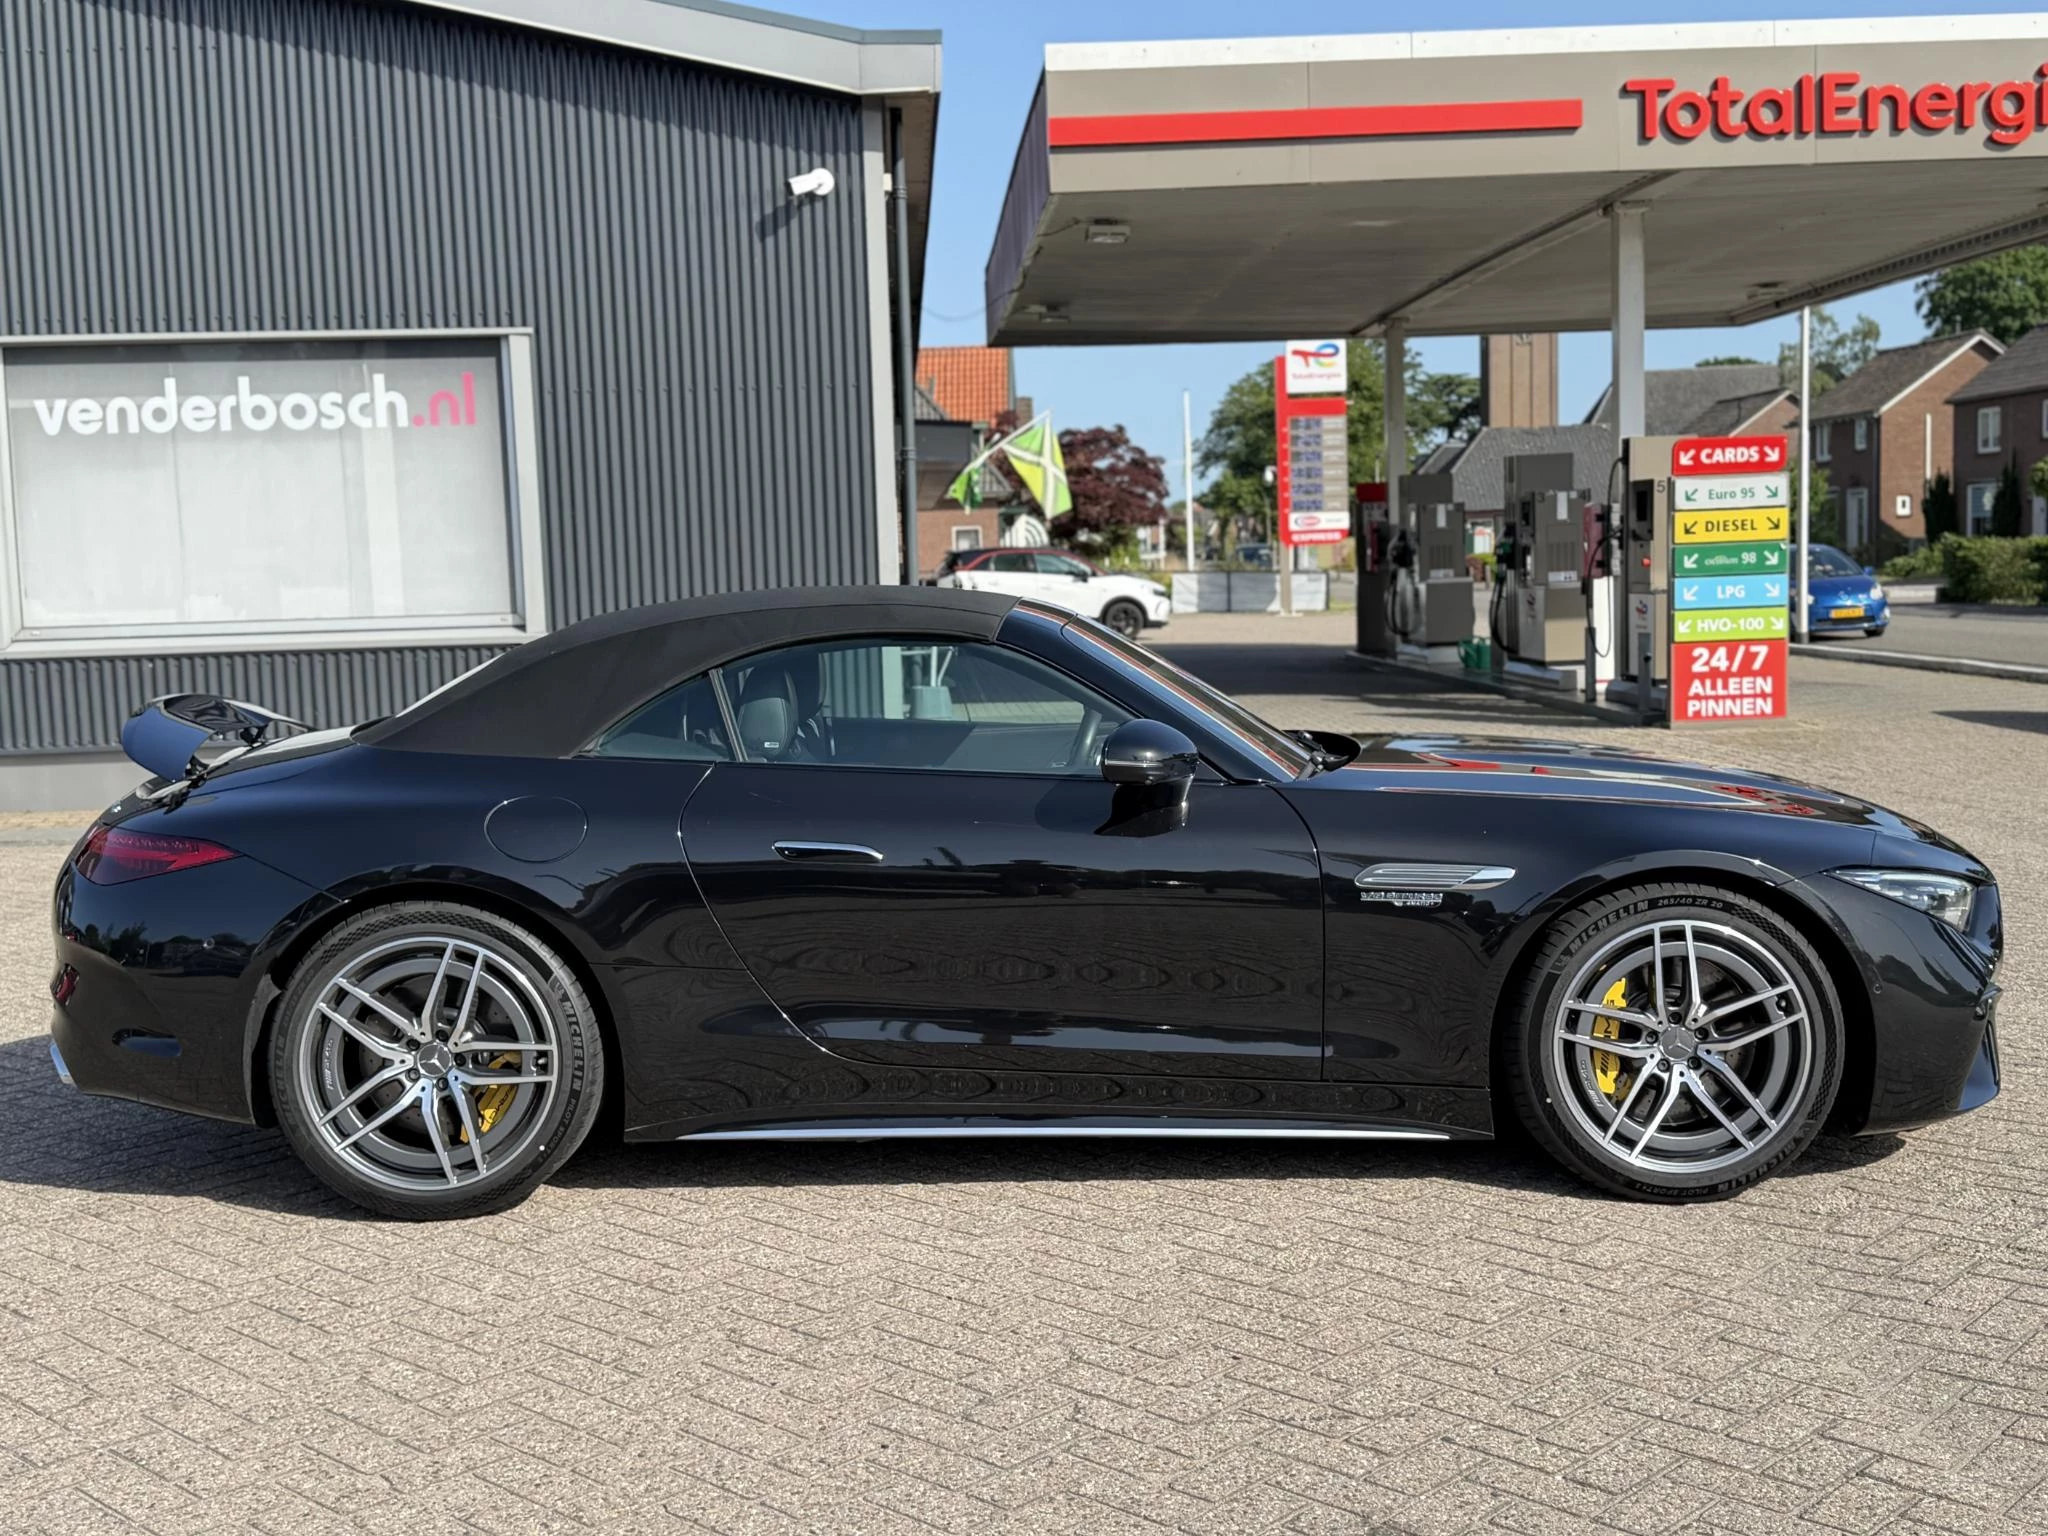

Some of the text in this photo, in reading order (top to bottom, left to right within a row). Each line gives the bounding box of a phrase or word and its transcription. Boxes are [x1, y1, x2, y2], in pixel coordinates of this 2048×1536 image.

[33, 371, 476, 436] venderbosch.nl
[1700, 445, 1759, 464] CARDS
[1656, 480, 1666, 493] 5
[1708, 487, 1755, 500] Euro 95
[1705, 519, 1757, 532] DIESEL
[1741, 551, 1757, 564] 98
[1717, 585, 1745, 599] LPG
[1697, 617, 1764, 632] HVO-100
[1691, 645, 1769, 673] 24/7
[1688, 677, 1772, 696] ALLEEN
[1687, 698, 1772, 717] PINNEN
[1568, 900, 1649, 956] MICHELIN
[562, 1001, 584, 1091] MICHELIN
[1718, 1140, 1797, 1192] MICHELIN
